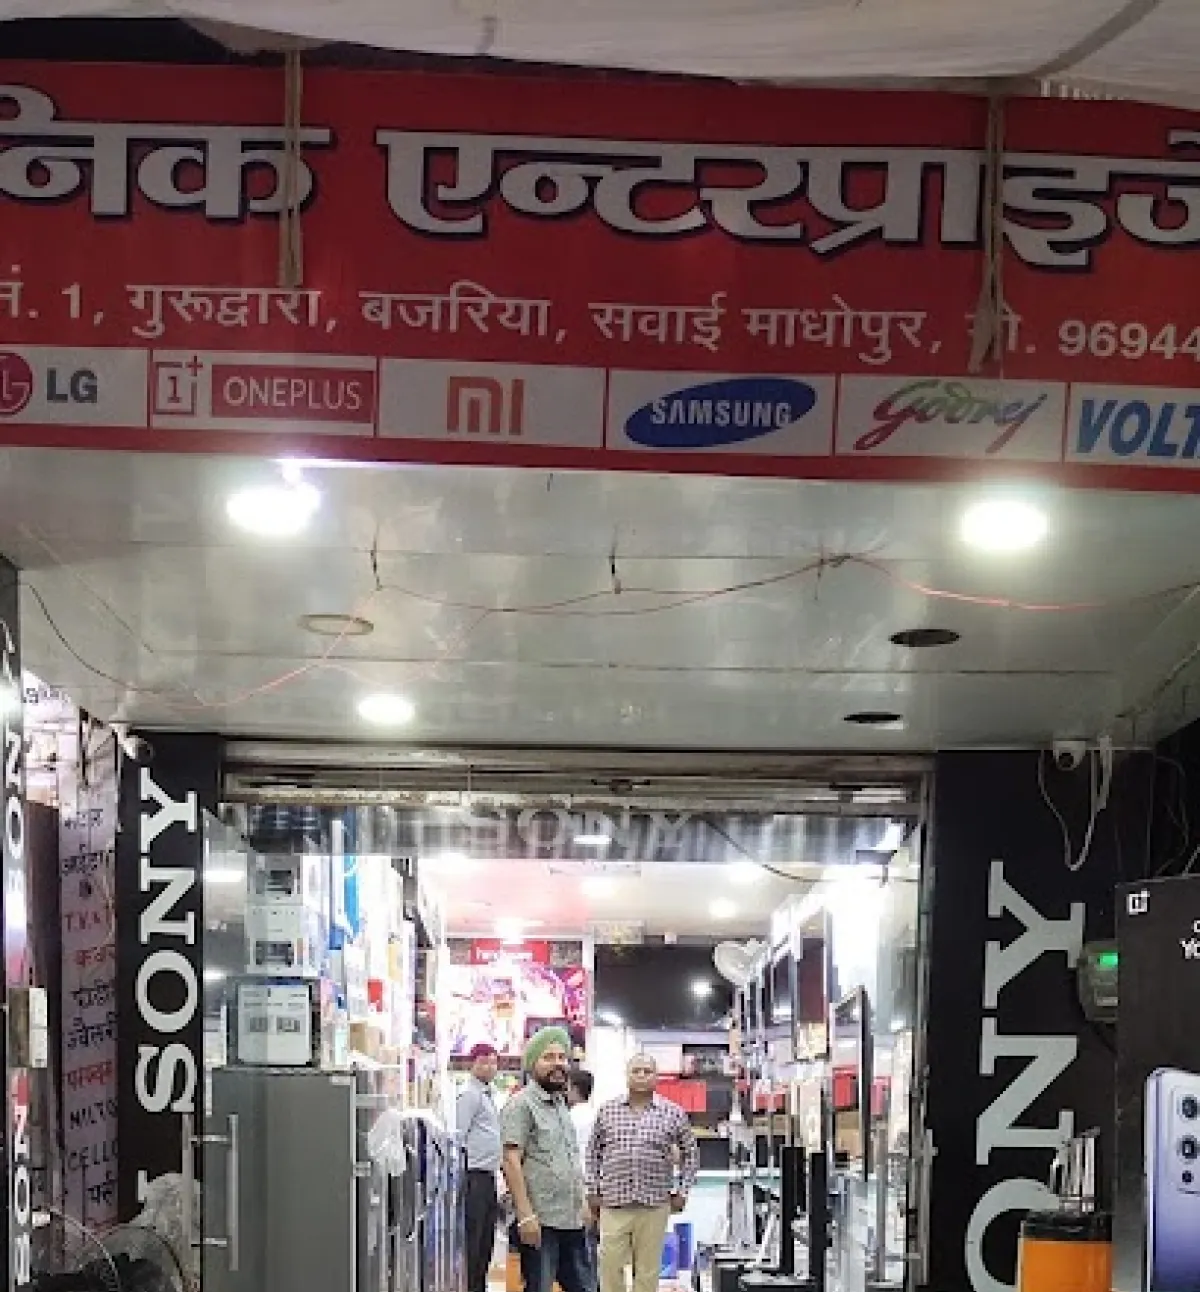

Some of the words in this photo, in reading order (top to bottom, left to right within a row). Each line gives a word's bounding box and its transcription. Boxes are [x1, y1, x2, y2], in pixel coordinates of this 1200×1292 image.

[358, 279, 567, 342] बजरिया,
[588, 291, 727, 352] सवाई
[741, 294, 942, 365] माधोपुर,
[46, 369, 98, 403] LG
[222, 375, 362, 412] ONEPLUS
[651, 397, 793, 430] SAMSUNG
[853, 380, 1048, 453] Godrej
[136, 768, 197, 1113] SONY
